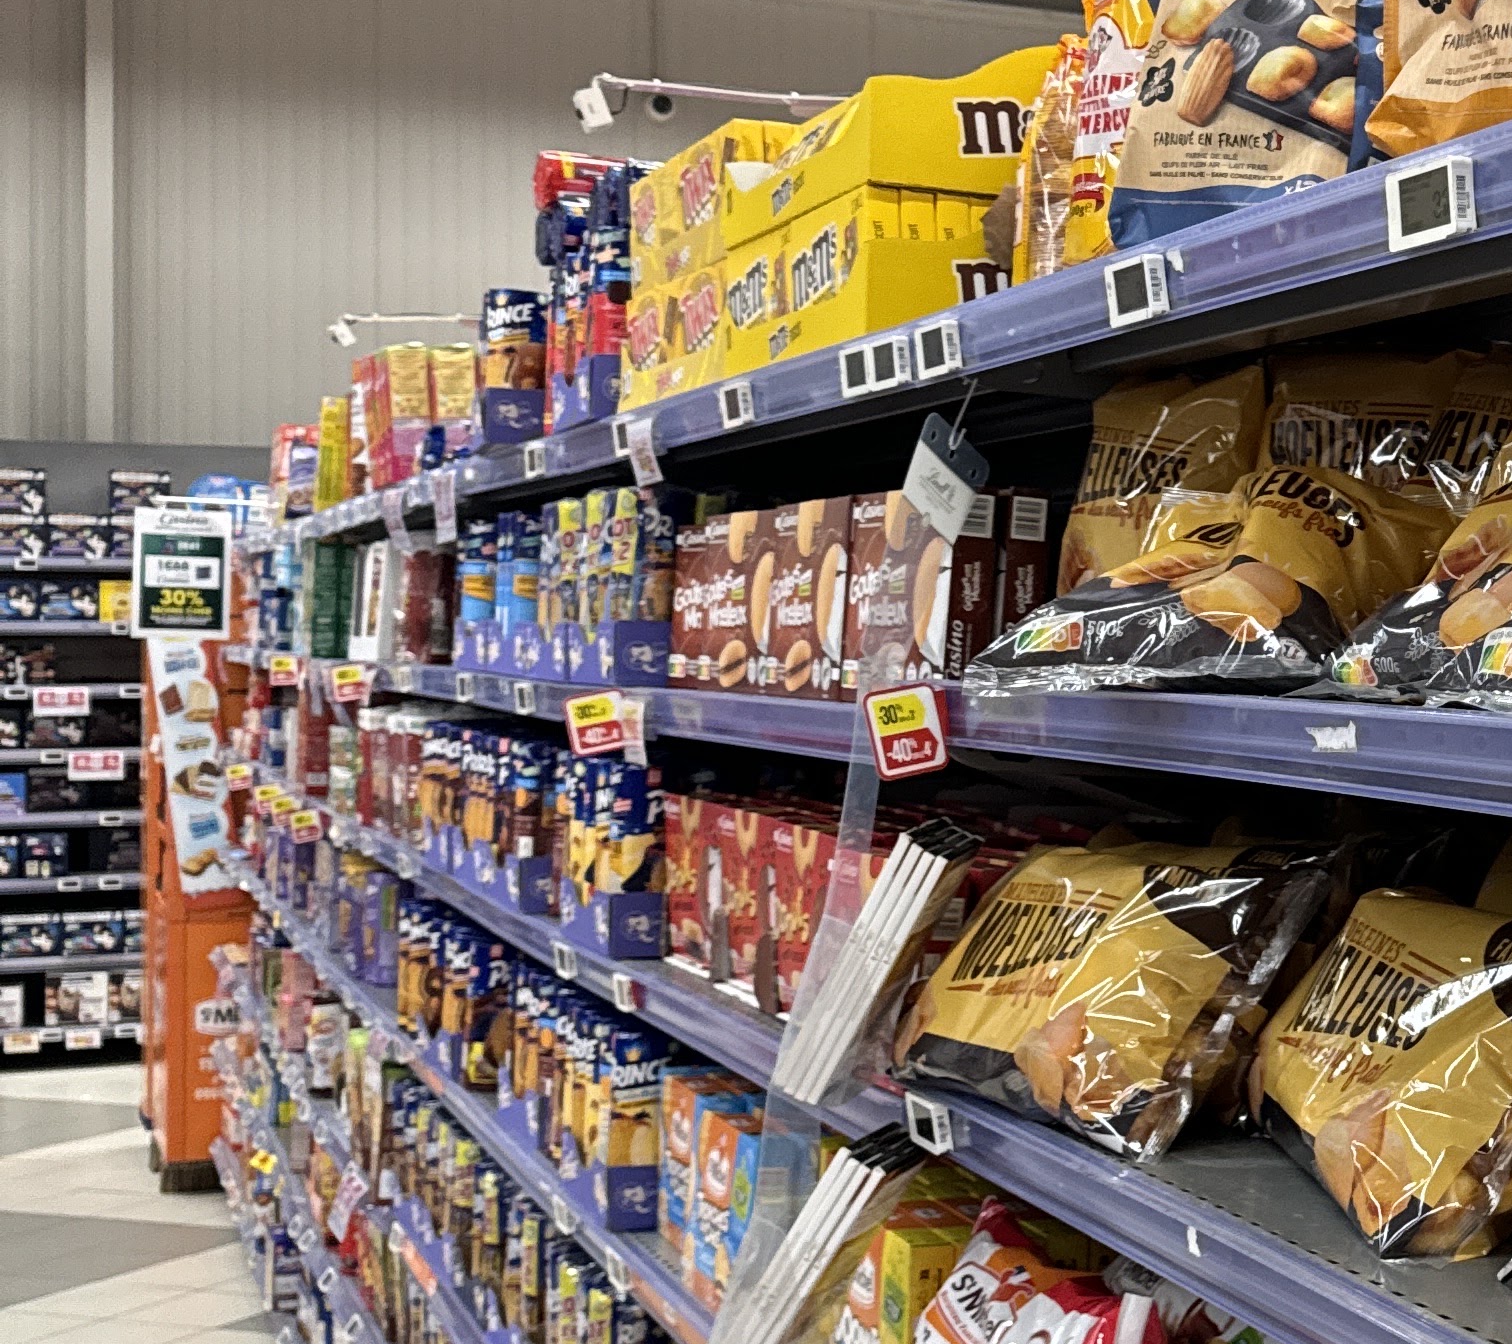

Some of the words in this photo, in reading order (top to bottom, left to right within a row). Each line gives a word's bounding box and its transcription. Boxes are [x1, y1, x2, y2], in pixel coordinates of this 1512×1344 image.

[1153, 129, 1194, 148] FABRIQUÉ
[1197, 132, 1213, 146] EN
[1217, 131, 1261, 150] FRANCE
[159, 588, 205, 608] 30%
